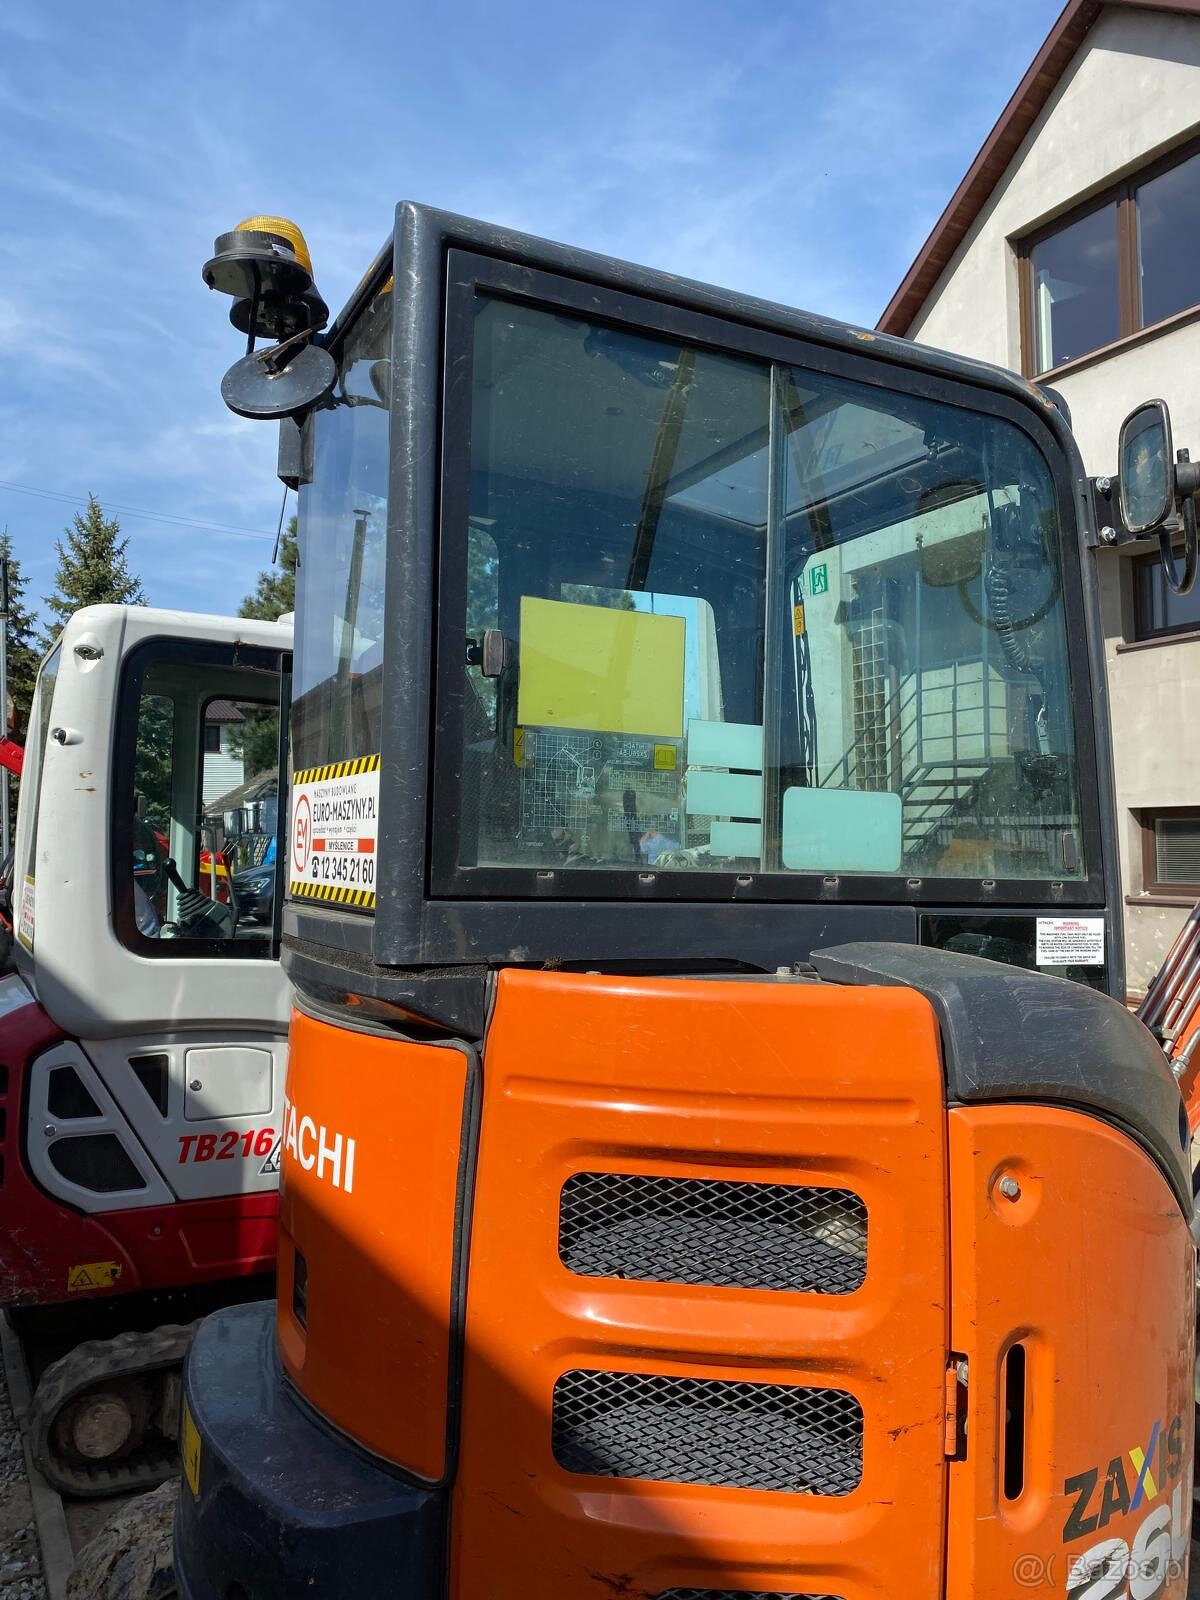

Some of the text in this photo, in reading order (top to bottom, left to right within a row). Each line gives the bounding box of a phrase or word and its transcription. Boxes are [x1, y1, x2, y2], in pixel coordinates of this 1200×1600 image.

[331, 784, 357, 797] BUDOWLANE
[313, 796, 376, 822] EURO-MASZYNY.PL
[328, 840, 354, 851] MYŚLENICE
[322, 856, 374, 885] 12 345 21 60
[178, 1128, 275, 1164] TB216
[1063, 1415, 1183, 1543] ZAXIS
